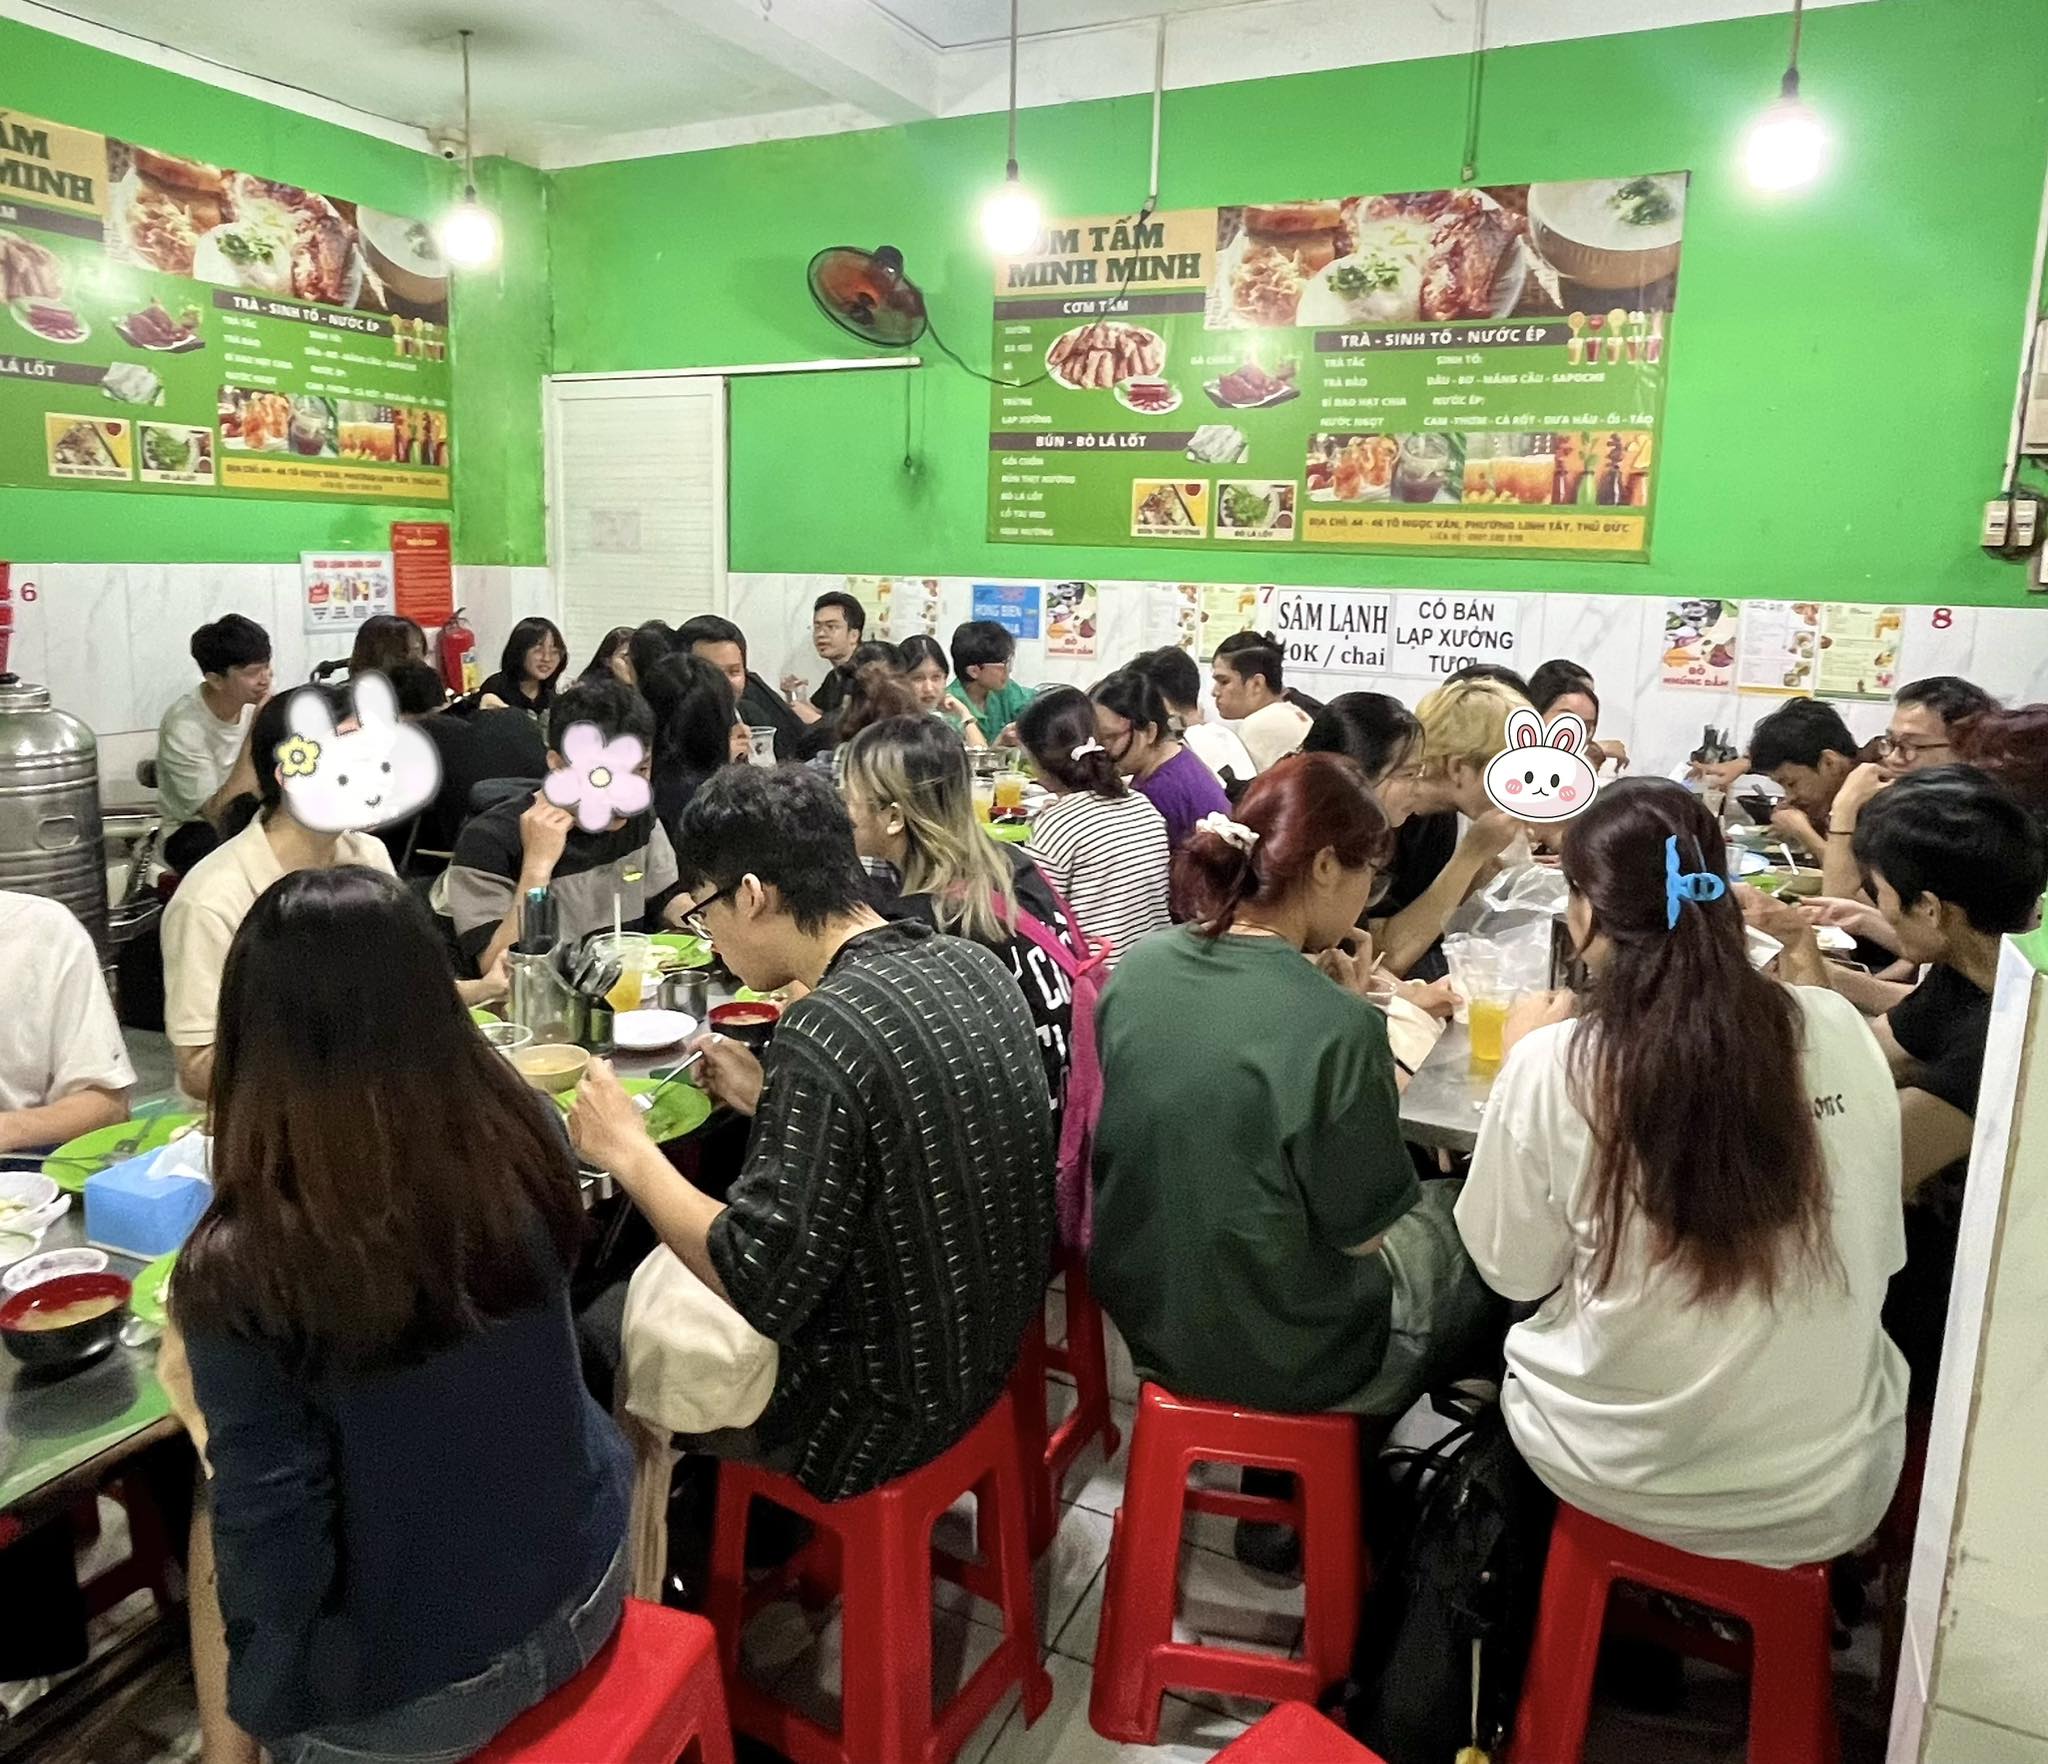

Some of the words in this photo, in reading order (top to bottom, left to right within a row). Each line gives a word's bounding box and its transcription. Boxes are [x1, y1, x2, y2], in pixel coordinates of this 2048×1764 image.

[1089, 216, 1164, 252] TẤM
[1008, 259, 1097, 287] MINH
[1106, 252, 1201, 282] MINH
[1341, 332, 1371, 347] TRÀ
[1385, 333, 1425, 346] SINH
[1430, 328, 1452, 344] TỐ
[1468, 326, 1521, 343] NƯỚC
[1526, 325, 1547, 341] ÉP
[1036, 434, 1064, 447] BÚN
[1076, 433, 1096, 447] BÒ
[1099, 434, 1117, 447] LÁ
[1120, 432, 1148, 447] LỐT
[21, 582, 37, 602] 6
[1259, 586, 1275, 604] 7
[1278, 594, 1323, 631] SÂM
[1328, 604, 1388, 640] LẠNH
[1419, 597, 1447, 620] CÓ
[1453, 598, 1494, 622] BÁN
[1932, 607, 1952, 629] 8
[1396, 626, 1433, 650] LẠP
[1284, 642, 1319, 662] 0K
[1341, 645, 1385, 666] chai
